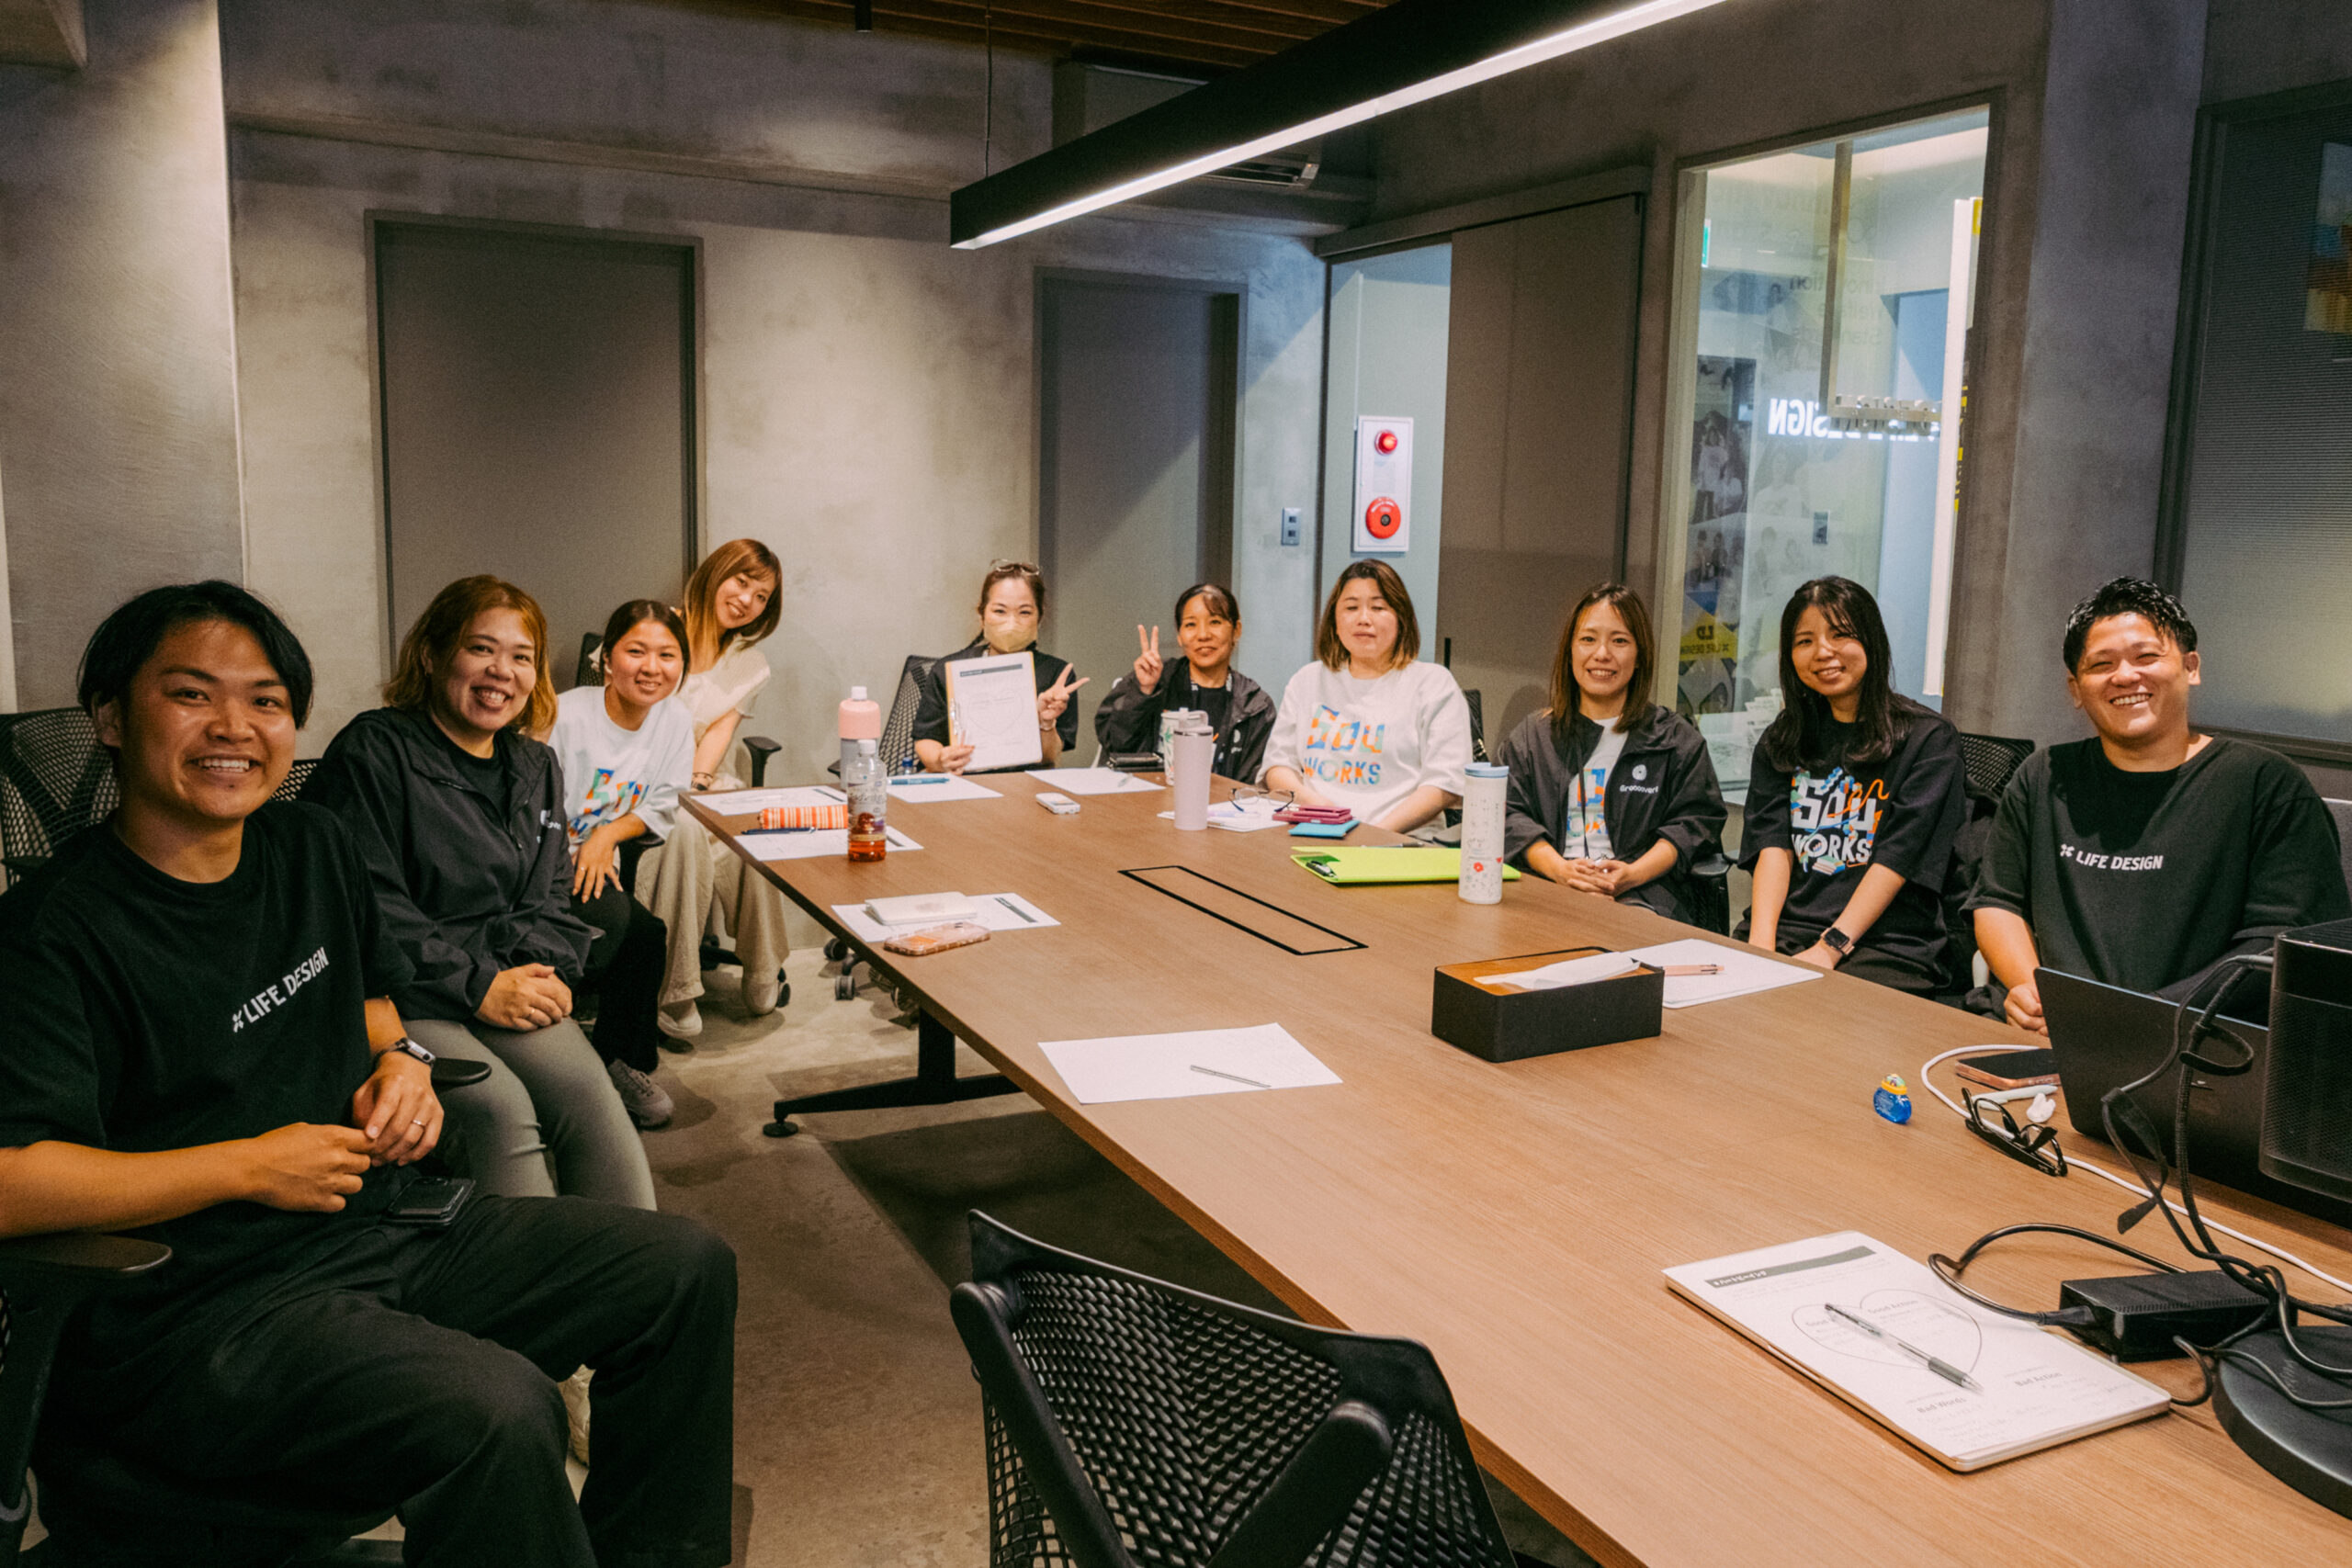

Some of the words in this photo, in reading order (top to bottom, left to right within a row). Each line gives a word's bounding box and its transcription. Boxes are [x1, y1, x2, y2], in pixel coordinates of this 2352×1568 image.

[1304, 756, 1381, 785] WORKS
[1792, 833, 1872, 863] WORKS
[2076, 851, 2109, 869] LIFE
[2110, 855, 2164, 871] DESIGN
[243, 985, 287, 1023] LIFE
[282, 946, 330, 996] DESIGN
